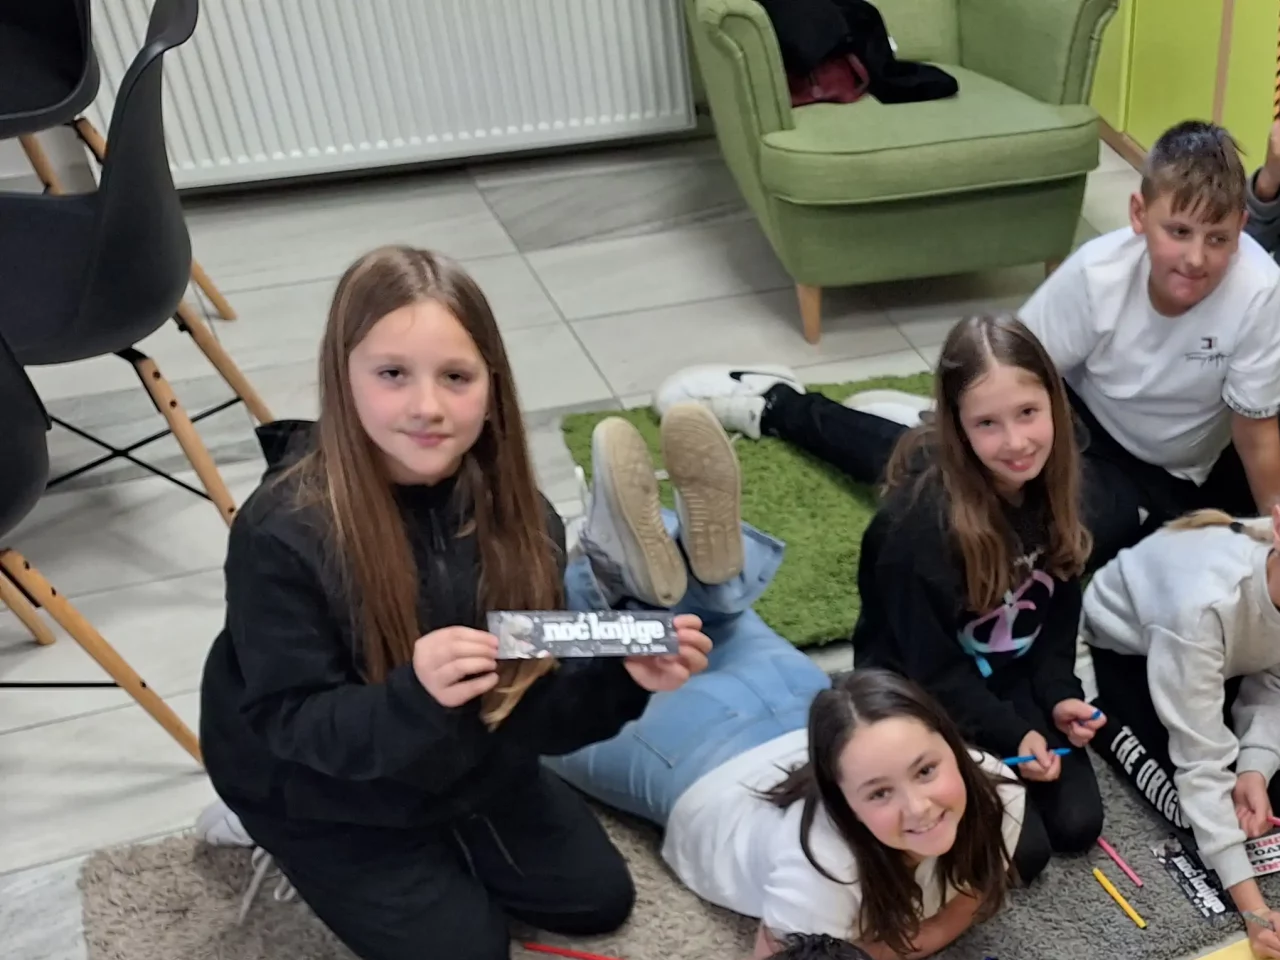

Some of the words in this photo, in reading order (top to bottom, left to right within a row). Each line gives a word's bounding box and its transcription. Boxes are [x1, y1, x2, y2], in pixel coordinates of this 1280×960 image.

[542, 611, 589, 642] noć
[589, 612, 665, 645] knjige
[1111, 726, 1146, 775] THE
[1170, 852, 1199, 882] noć
[1186, 866, 1226, 914] knjige
